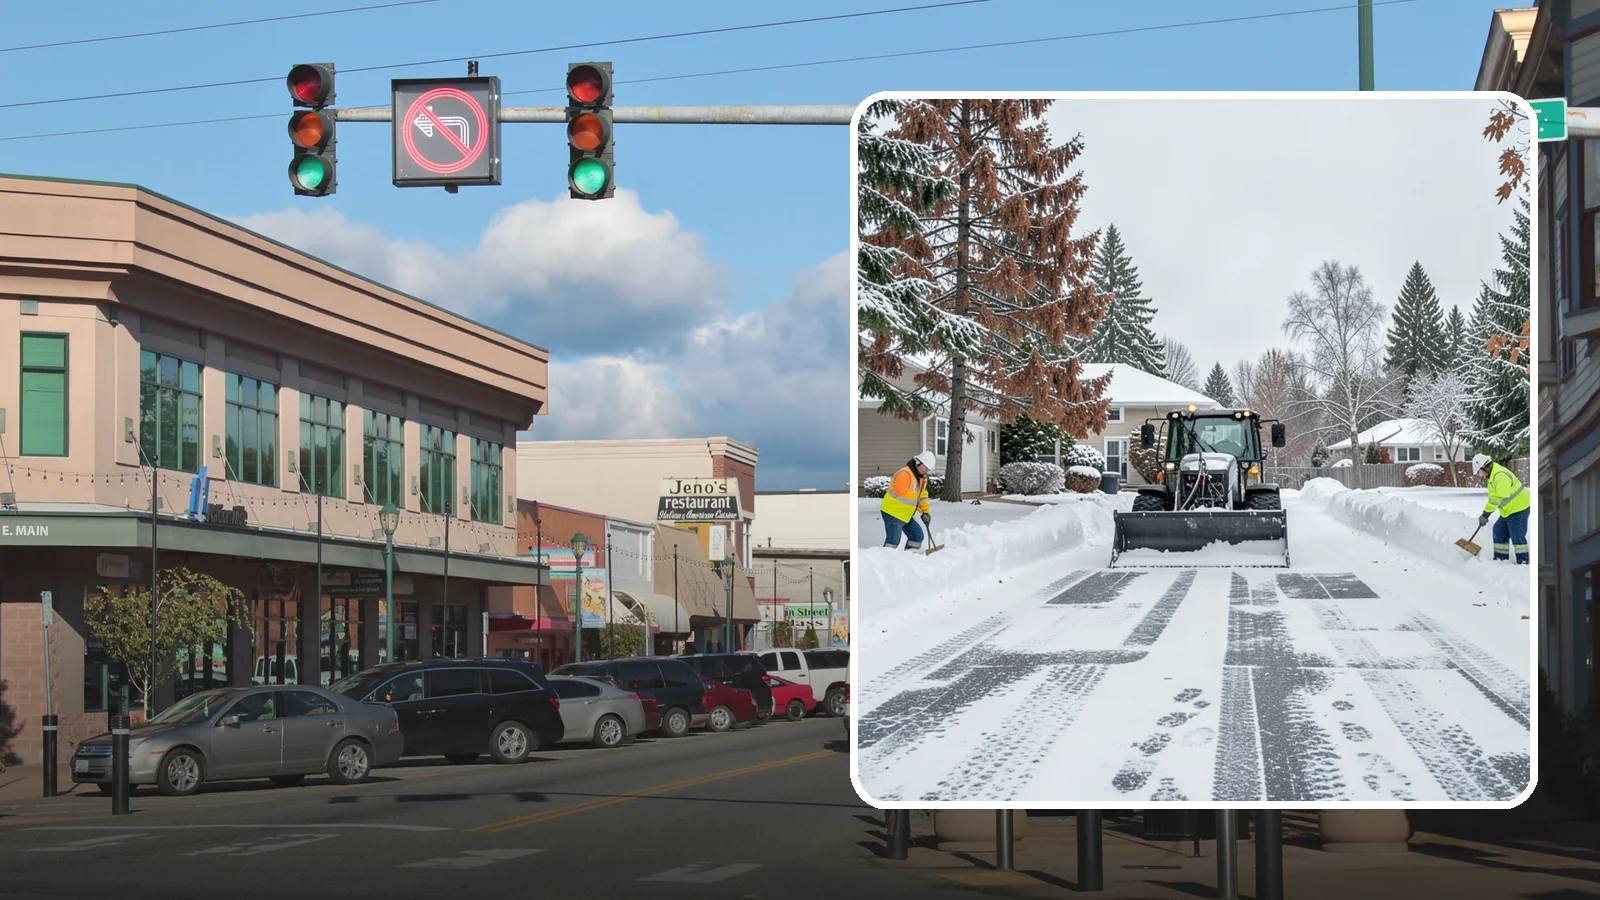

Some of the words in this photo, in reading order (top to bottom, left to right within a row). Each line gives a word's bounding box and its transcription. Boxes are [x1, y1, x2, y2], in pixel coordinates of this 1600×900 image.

[670, 480, 727, 494] Jeno's
[665, 496, 731, 509] restaurant
[686, 510, 714, 519] American
[715, 509, 737, 519] Cuisine
[2, 525, 13, 536] E.
[15, 525, 49, 536] MAIN
[797, 607, 828, 616] Street
[790, 619, 823, 627] lass
